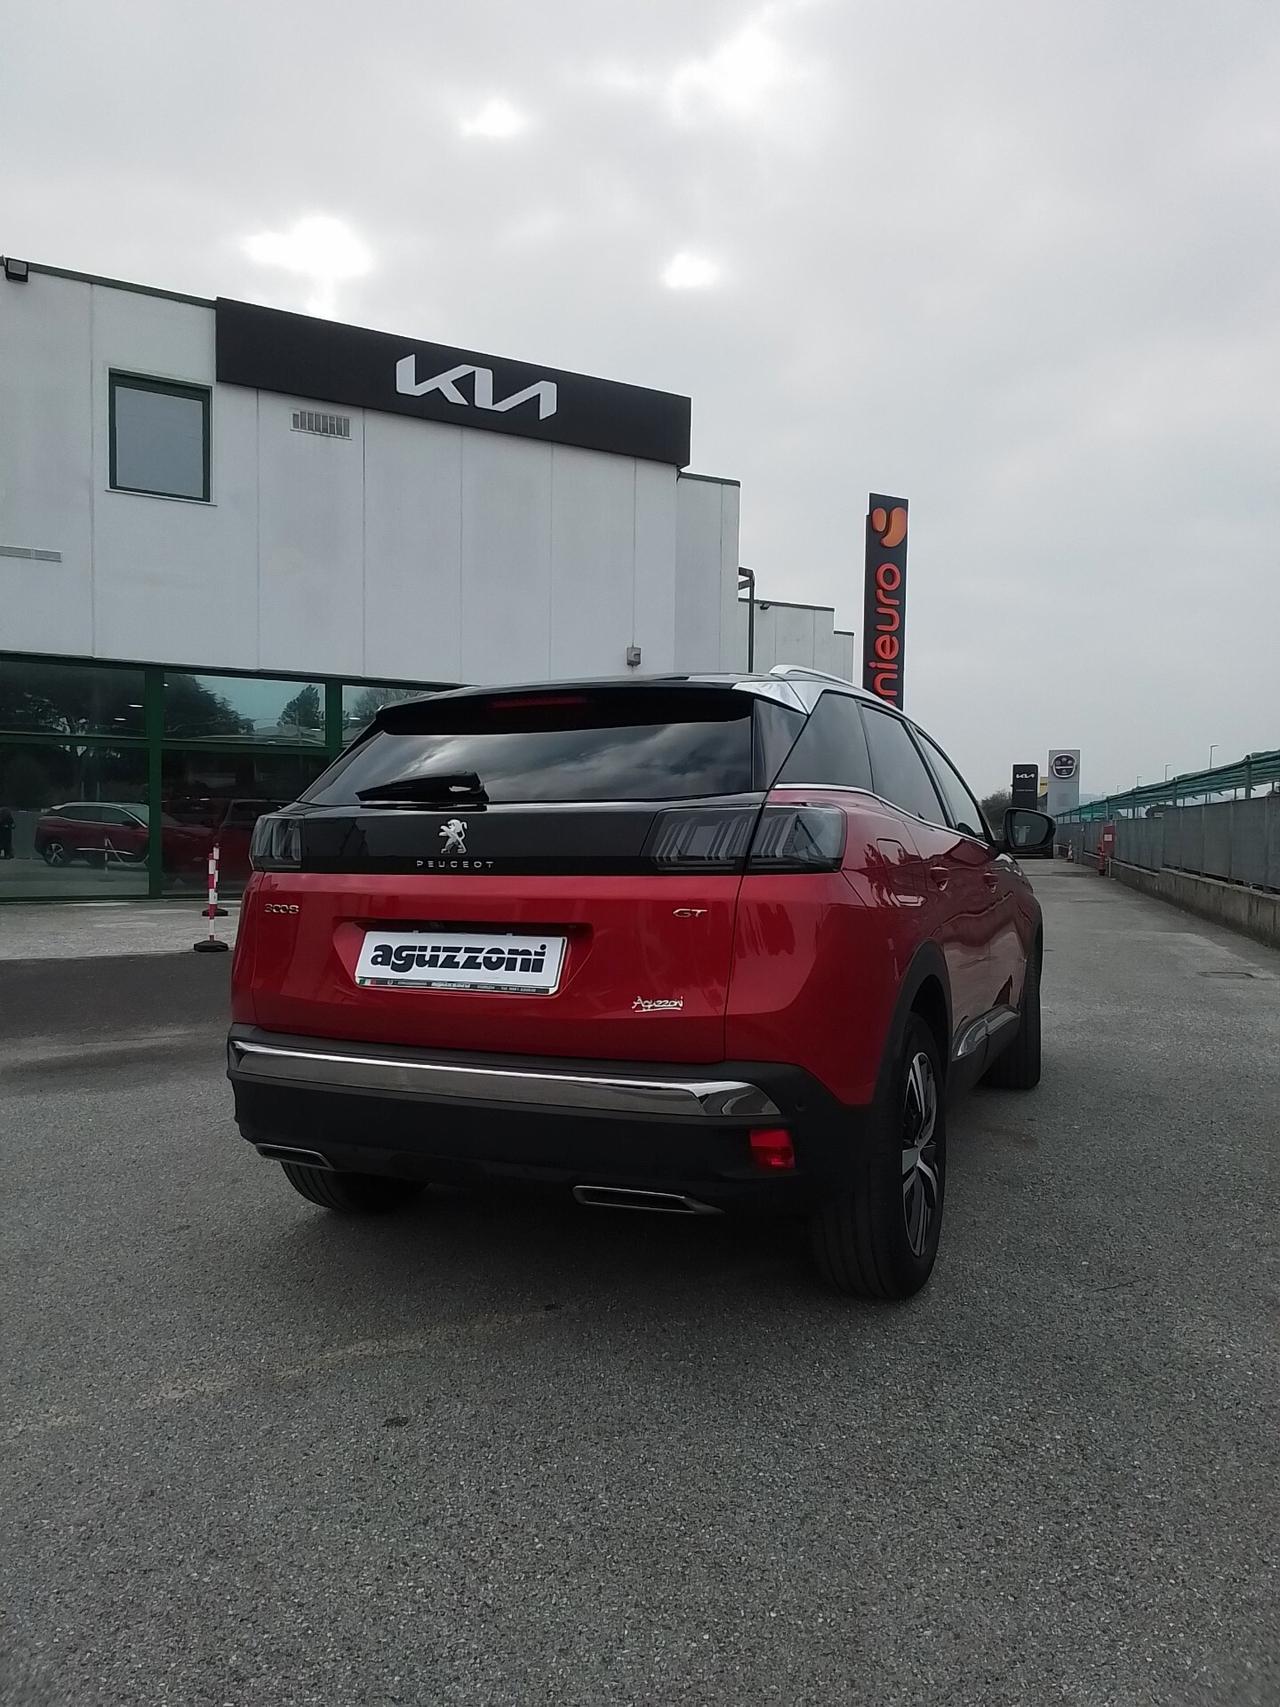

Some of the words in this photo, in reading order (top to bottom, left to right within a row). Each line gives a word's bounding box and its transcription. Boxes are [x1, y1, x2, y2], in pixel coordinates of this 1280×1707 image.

[396, 354, 557, 420] KIA
[868, 562, 902, 706] nieuro
[416, 860, 494, 868] PEUGEOT
[673, 908, 708, 917] GT
[370, 943, 547, 973] aguzzoni
